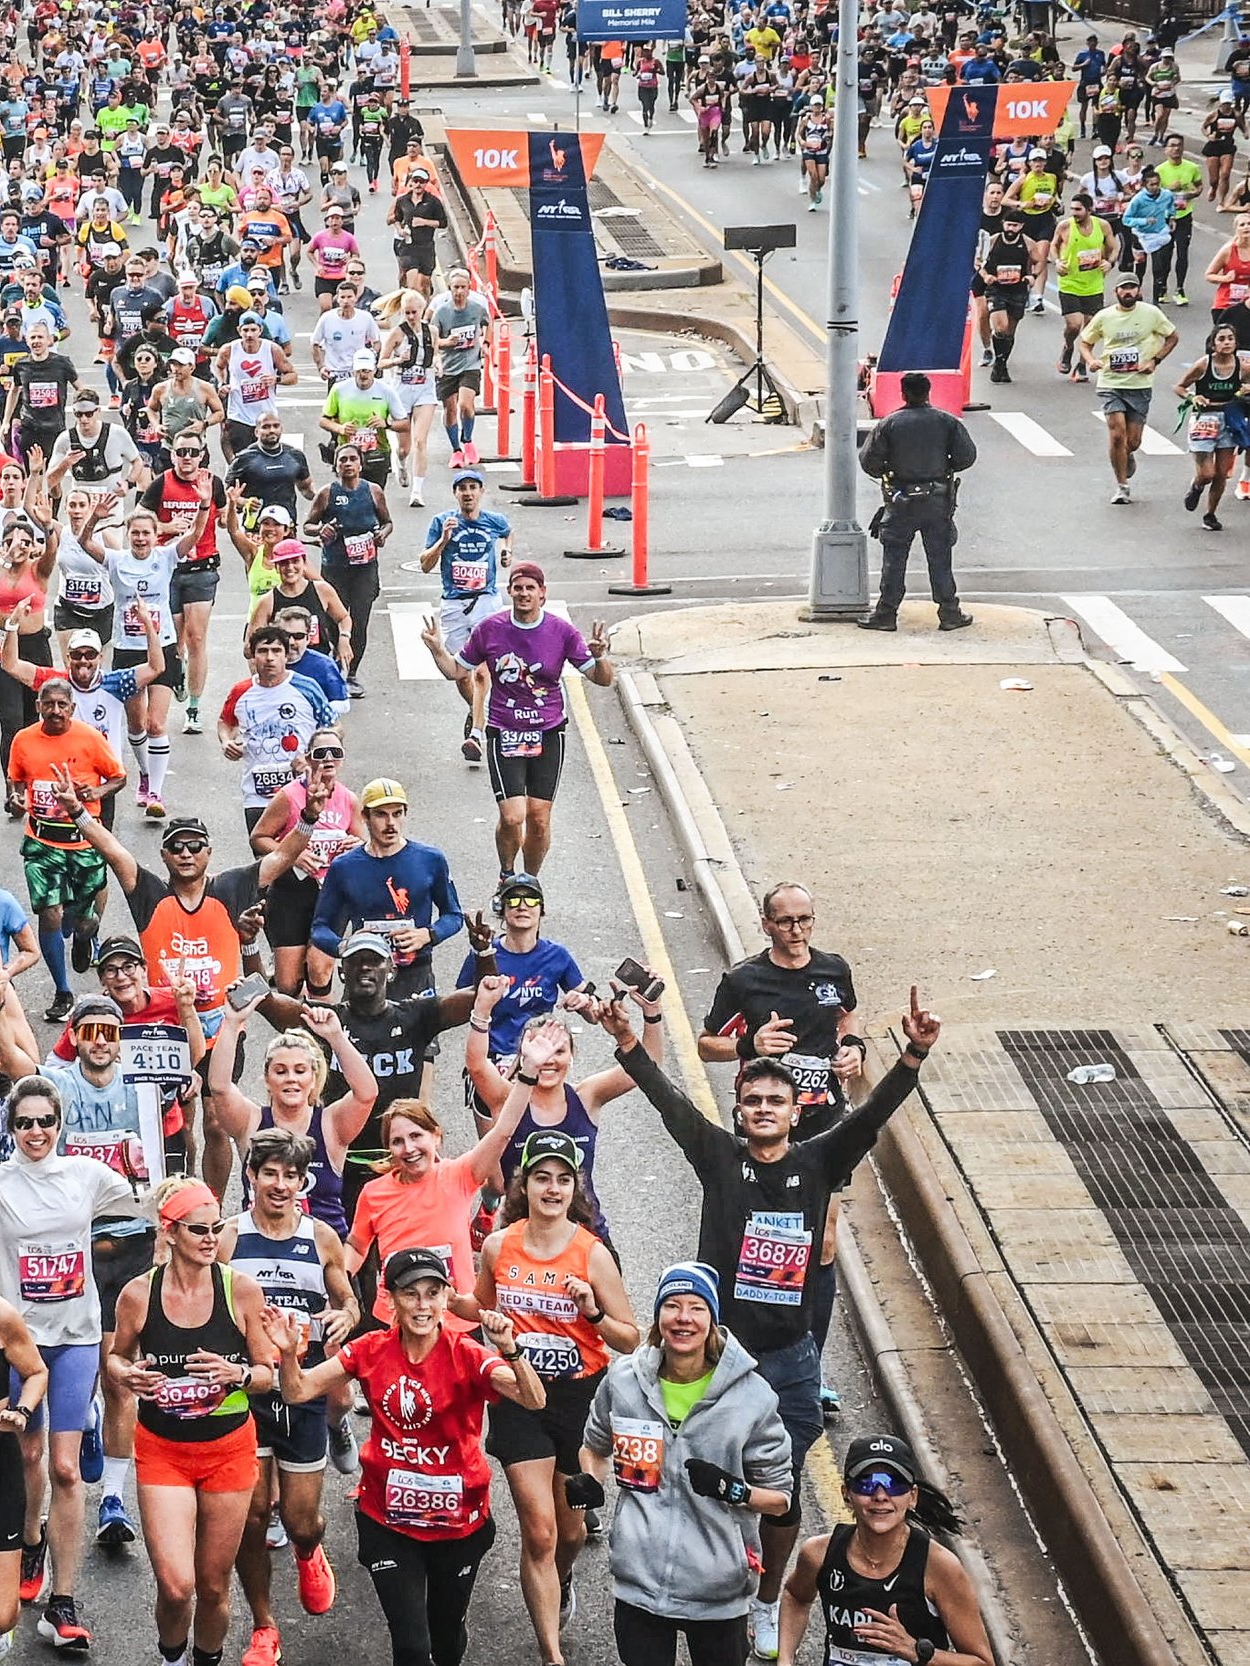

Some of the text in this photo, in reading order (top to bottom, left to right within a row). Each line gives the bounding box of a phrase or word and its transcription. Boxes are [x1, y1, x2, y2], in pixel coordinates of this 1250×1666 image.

[602, 7, 661, 17] BILL SHERRY
[1005, 100, 1048, 119] 10K
[473, 149, 518, 169] 10K
[1110, 353, 1138, 363] 37930
[1208, 382, 1234, 391] VEGAN
[453, 567, 487, 579] 30408
[67, 581, 99, 592] 31443
[513, 708, 539, 720] Run
[529, 717, 545, 725] Run
[255, 772, 294, 787] 26834
[171, 932, 209, 955] asha
[520, 986, 543, 998] NYC
[133, 1053, 181, 1070] 4:10
[755, 1215, 801, 1229] ANKIT
[745, 1237, 807, 1266] 36878
[27, 1254, 77, 1278] 51747
[538, 1299, 575, 1313] TEAM
[381, 1438, 450, 1466] BECKY
[870, 1439, 893, 1453] alo
[389, 1486, 458, 1510] 26386
